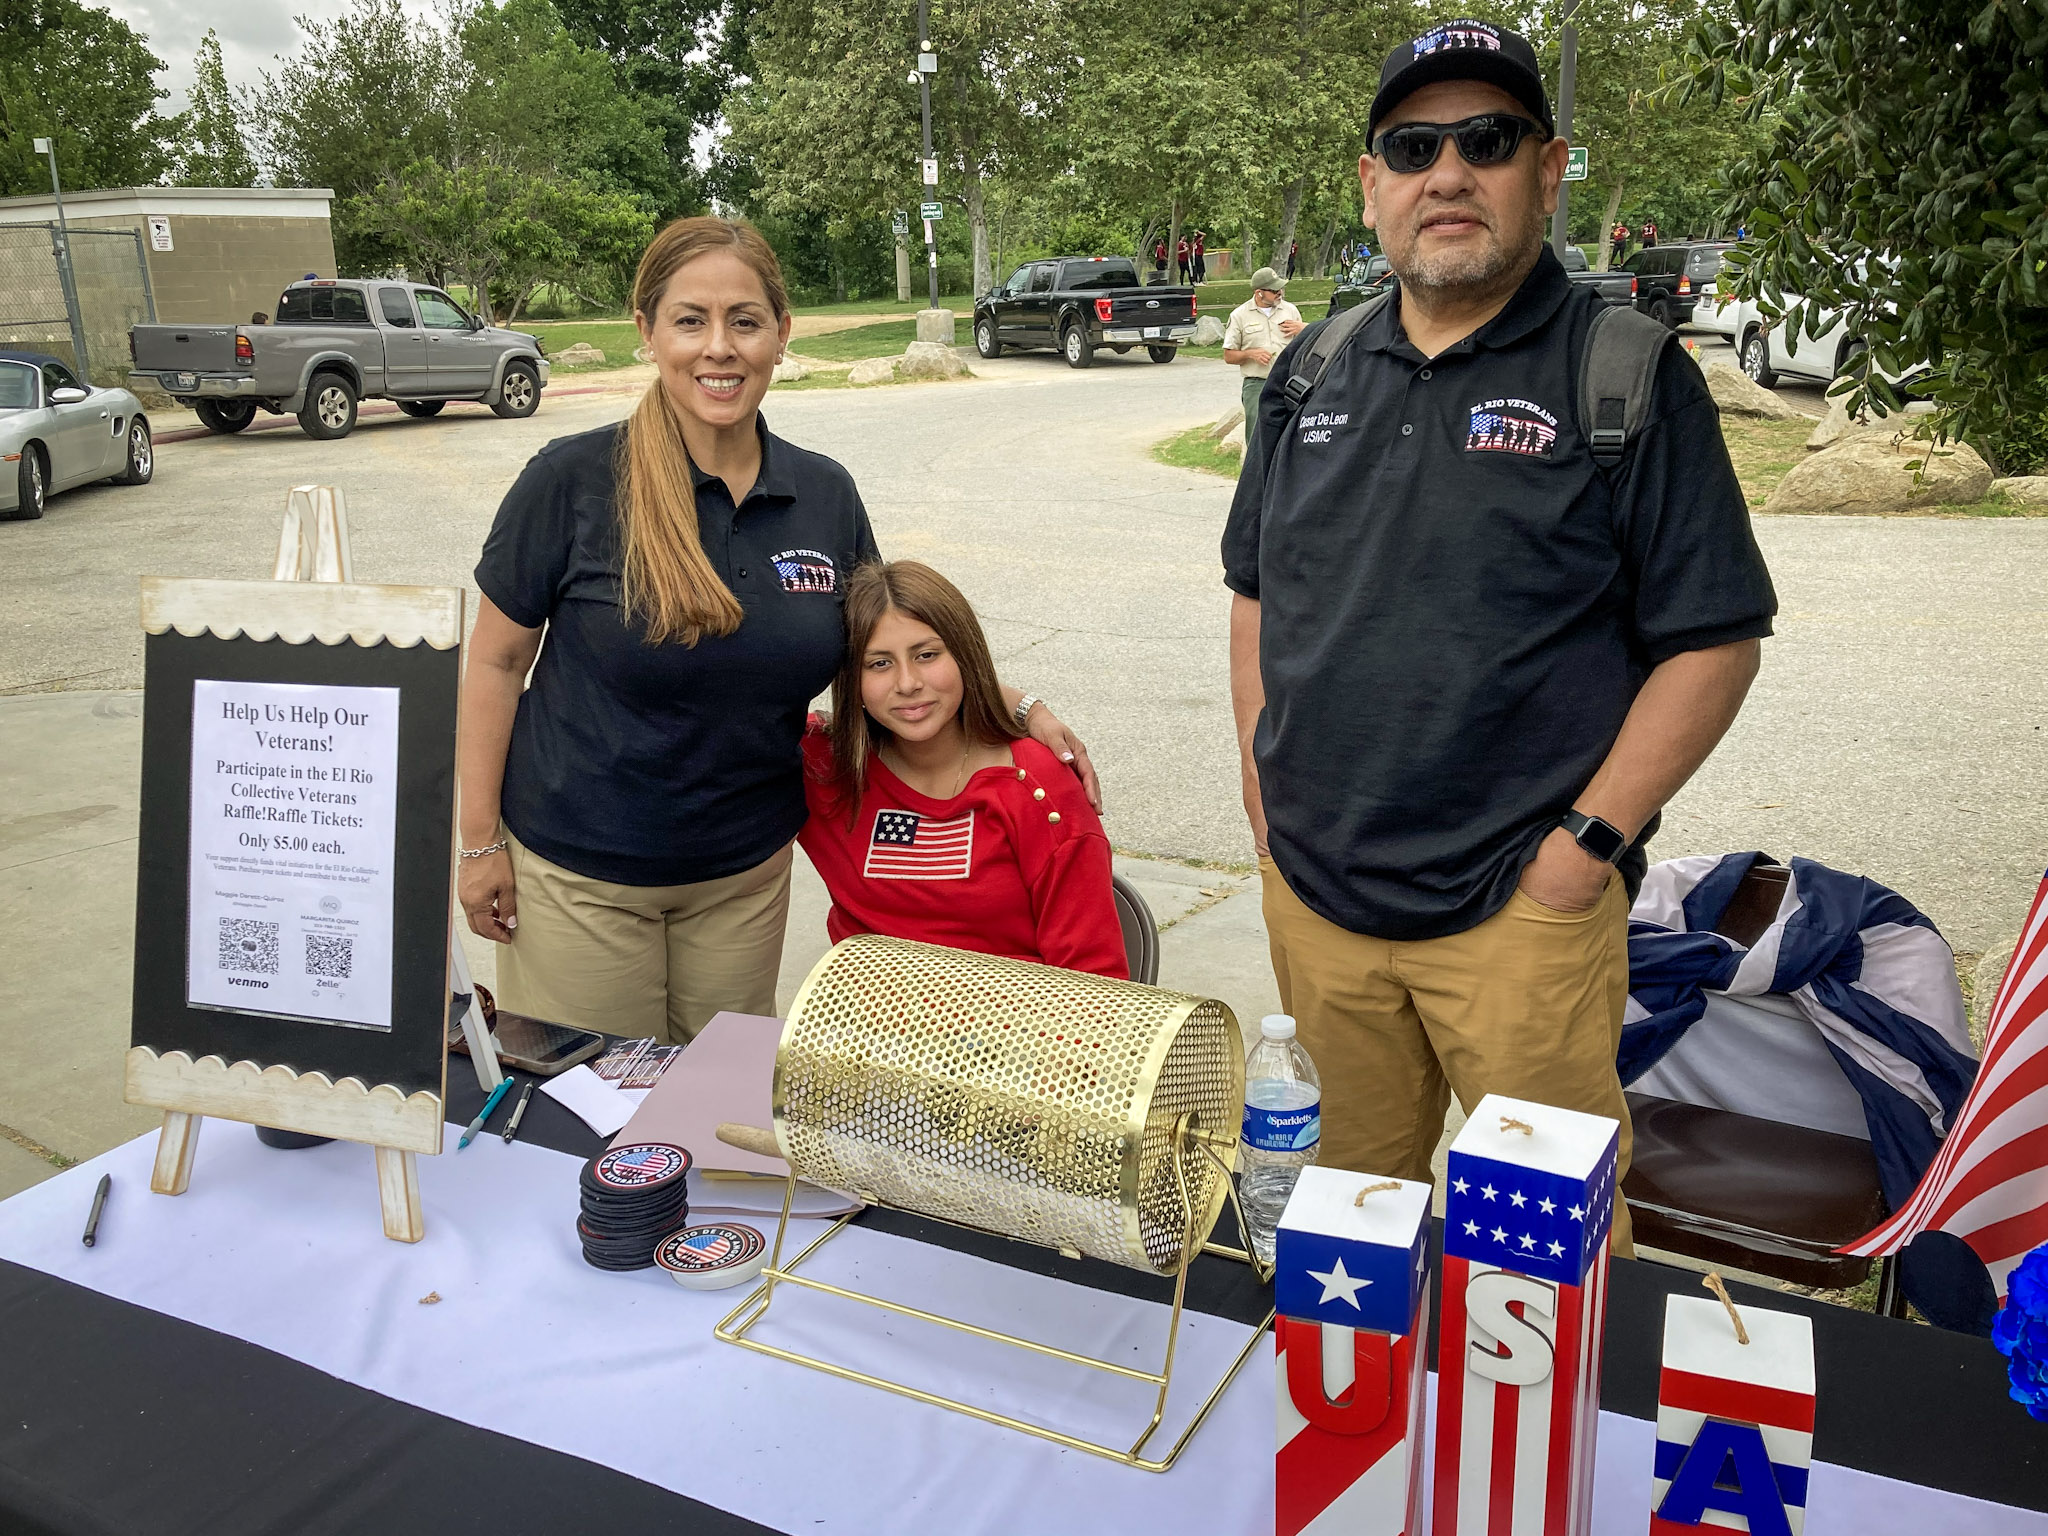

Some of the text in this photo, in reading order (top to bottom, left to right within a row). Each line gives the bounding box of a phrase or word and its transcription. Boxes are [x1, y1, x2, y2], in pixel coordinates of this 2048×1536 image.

[1426, 26, 1444, 36] RIO
[1447, 19, 1500, 38] VETERANS
[1570, 162, 1584, 173] only
[1317, 412, 1329, 426] De
[1329, 412, 1348, 425] Leon
[1470, 398, 1558, 427] EL RIO VETERANS
[1303, 430, 1332, 443] USMC
[770, 554, 782, 563] EL
[781, 550, 796, 559] RIO
[222, 702, 369, 728] Help Us Help Our
[256, 731, 333, 752] Veterans!
[216, 760, 373, 784] Participate in the El Rio
[231, 782, 357, 805] Collective Veterans
[224, 804, 363, 828] Raffle!Raffle Tickets:
[239, 832, 345, 855] Only $5.00 each.
[239, 865, 261, 873] Purchase
[228, 977, 269, 988] venmo
[316, 979, 339, 988] Zelle
[1271, 1114, 1312, 1128] Sparkletts
[602, 1161, 610, 1169] EL
[609, 1150, 629, 1160] RIO
[656, 1154, 680, 1178] ANGELES
[605, 1172, 646, 1184] VETERANS
[677, 1231, 698, 1241] RIO
[719, 1230, 737, 1241] LOS
[667, 1242, 678, 1250] EL
[711, 1240, 741, 1266] ANGELES
[666, 1254, 701, 1269] VETERANS
[1465, 1270, 1556, 1386] S
[1286, 1317, 1393, 1435] U
[1657, 1416, 1792, 1536] A
